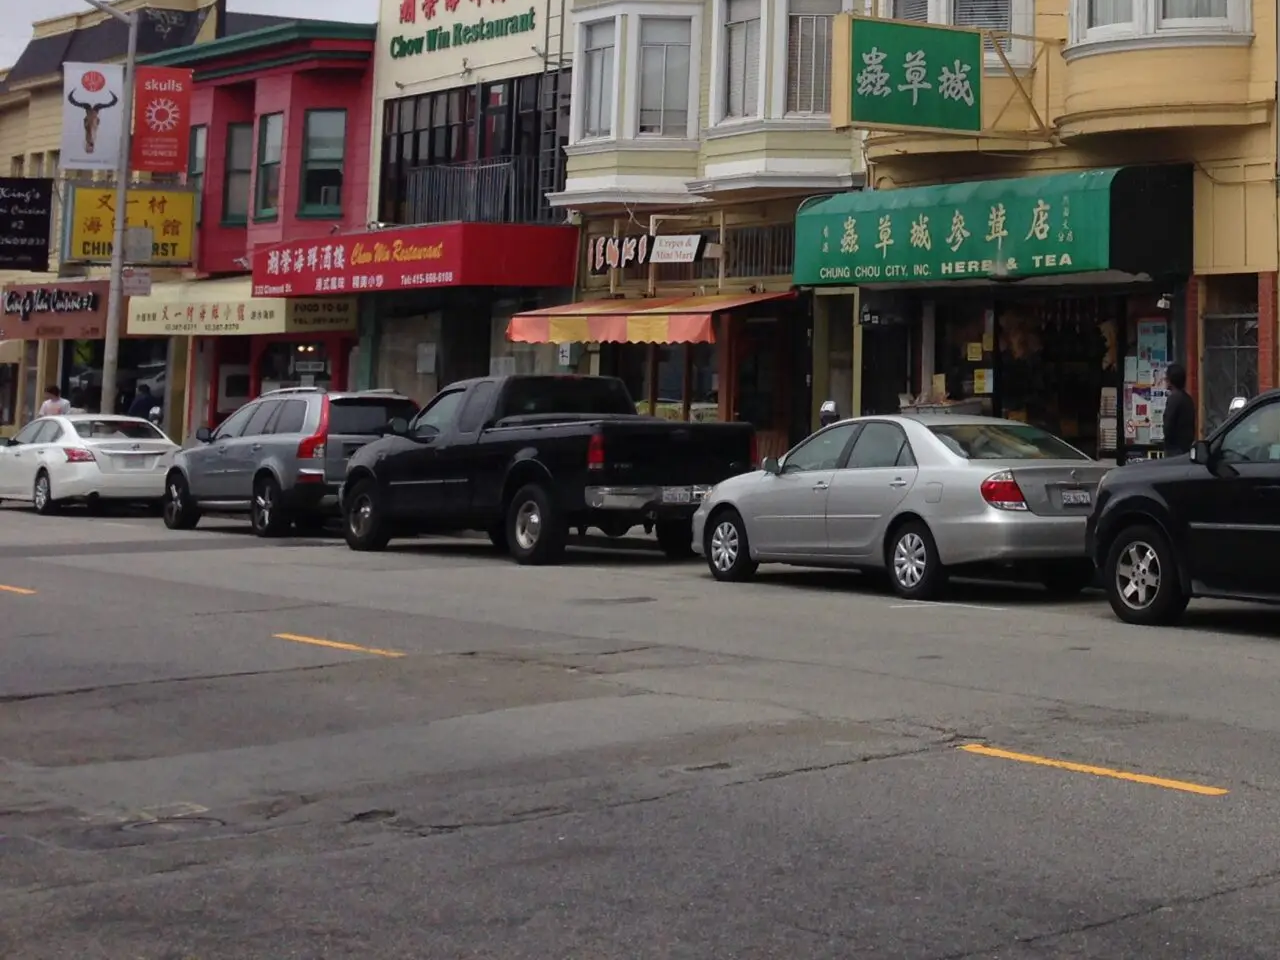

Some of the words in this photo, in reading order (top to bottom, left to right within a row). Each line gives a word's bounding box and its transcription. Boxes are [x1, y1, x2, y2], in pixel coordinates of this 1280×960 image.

[390, 36, 424, 60] Chow
[426, 26, 450, 52] Win
[452, 6, 536, 47] Restaurant
[144, 80, 183, 92] skulls
[856, 47, 975, 107] 蟲草城
[96, 194, 168, 214] 又一村
[83, 217, 182, 237] 海館
[841, 199, 1051, 259] 蟲草城參茸店
[82, 242, 114, 256] CHIN
[151, 242, 178, 256] RST
[351, 242, 372, 266] Chow
[374, 242, 390, 263] Win
[393, 239, 443, 262] Restaurant
[820, 266, 850, 279] CHUNG
[855, 265, 880, 278] CHOU
[885, 265, 908, 277] CITY,
[913, 264, 931, 275] INC.
[941, 259, 993, 274] HERB
[1006, 257, 1018, 270] &
[1032, 253, 1072, 268] TEA
[294, 303, 319, 313] FOOD
